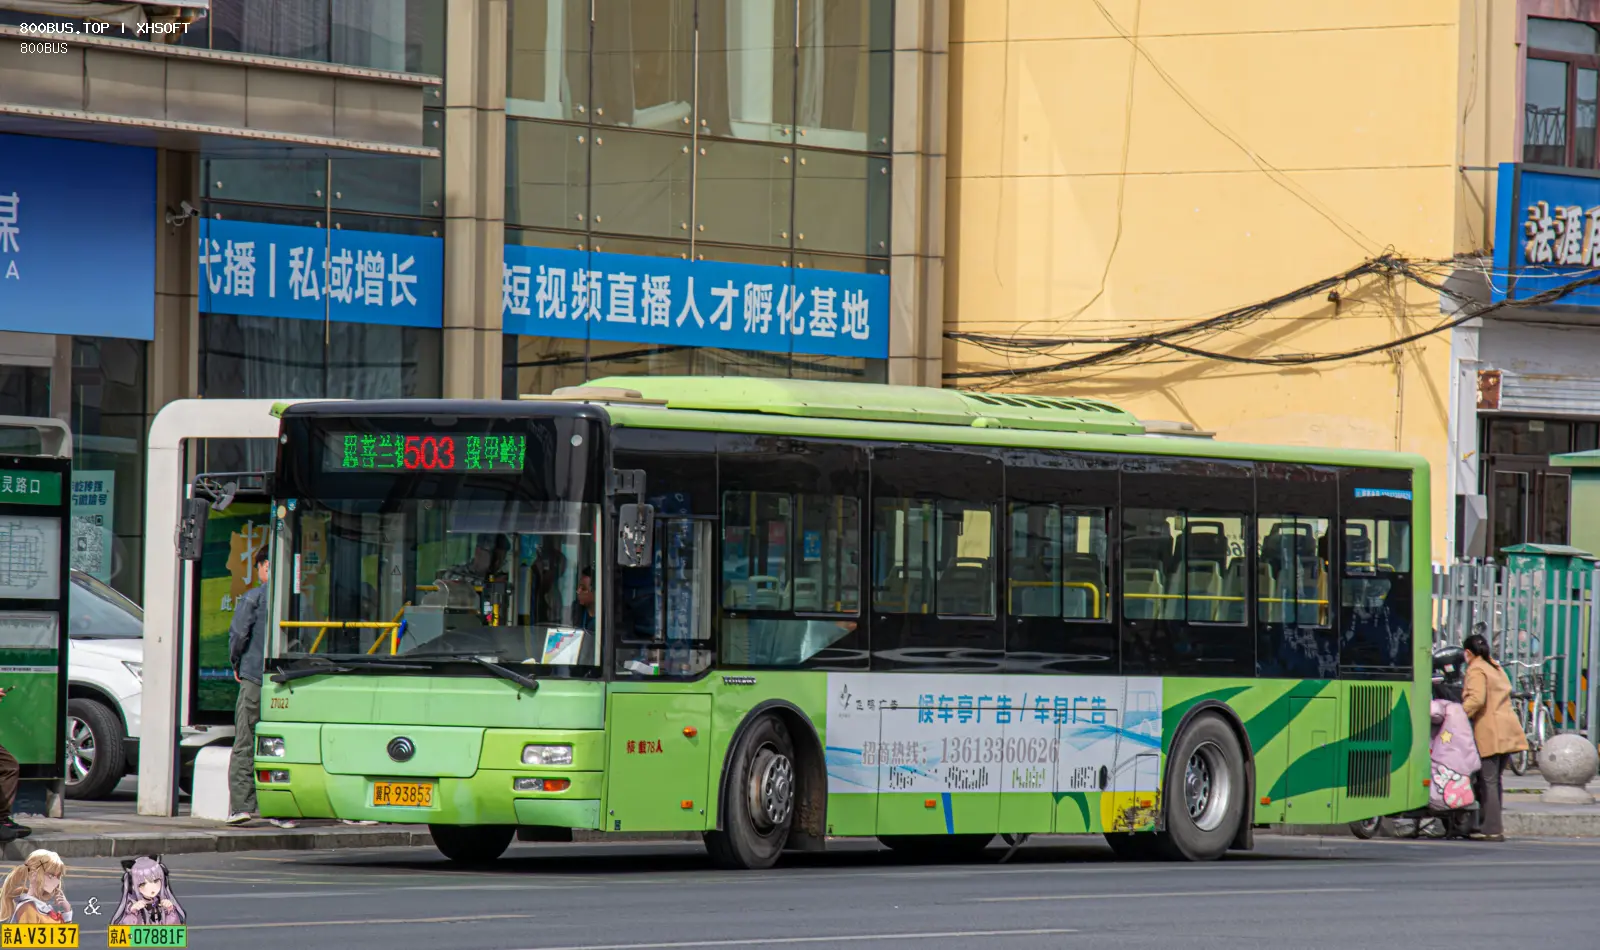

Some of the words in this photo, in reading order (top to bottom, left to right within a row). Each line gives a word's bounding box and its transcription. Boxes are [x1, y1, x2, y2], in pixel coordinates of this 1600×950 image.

[502, 262, 870, 341] 短视频直播人才孵化基地
[404, 435, 455, 469] 503
[940, 737, 1059, 764] 13613360626
